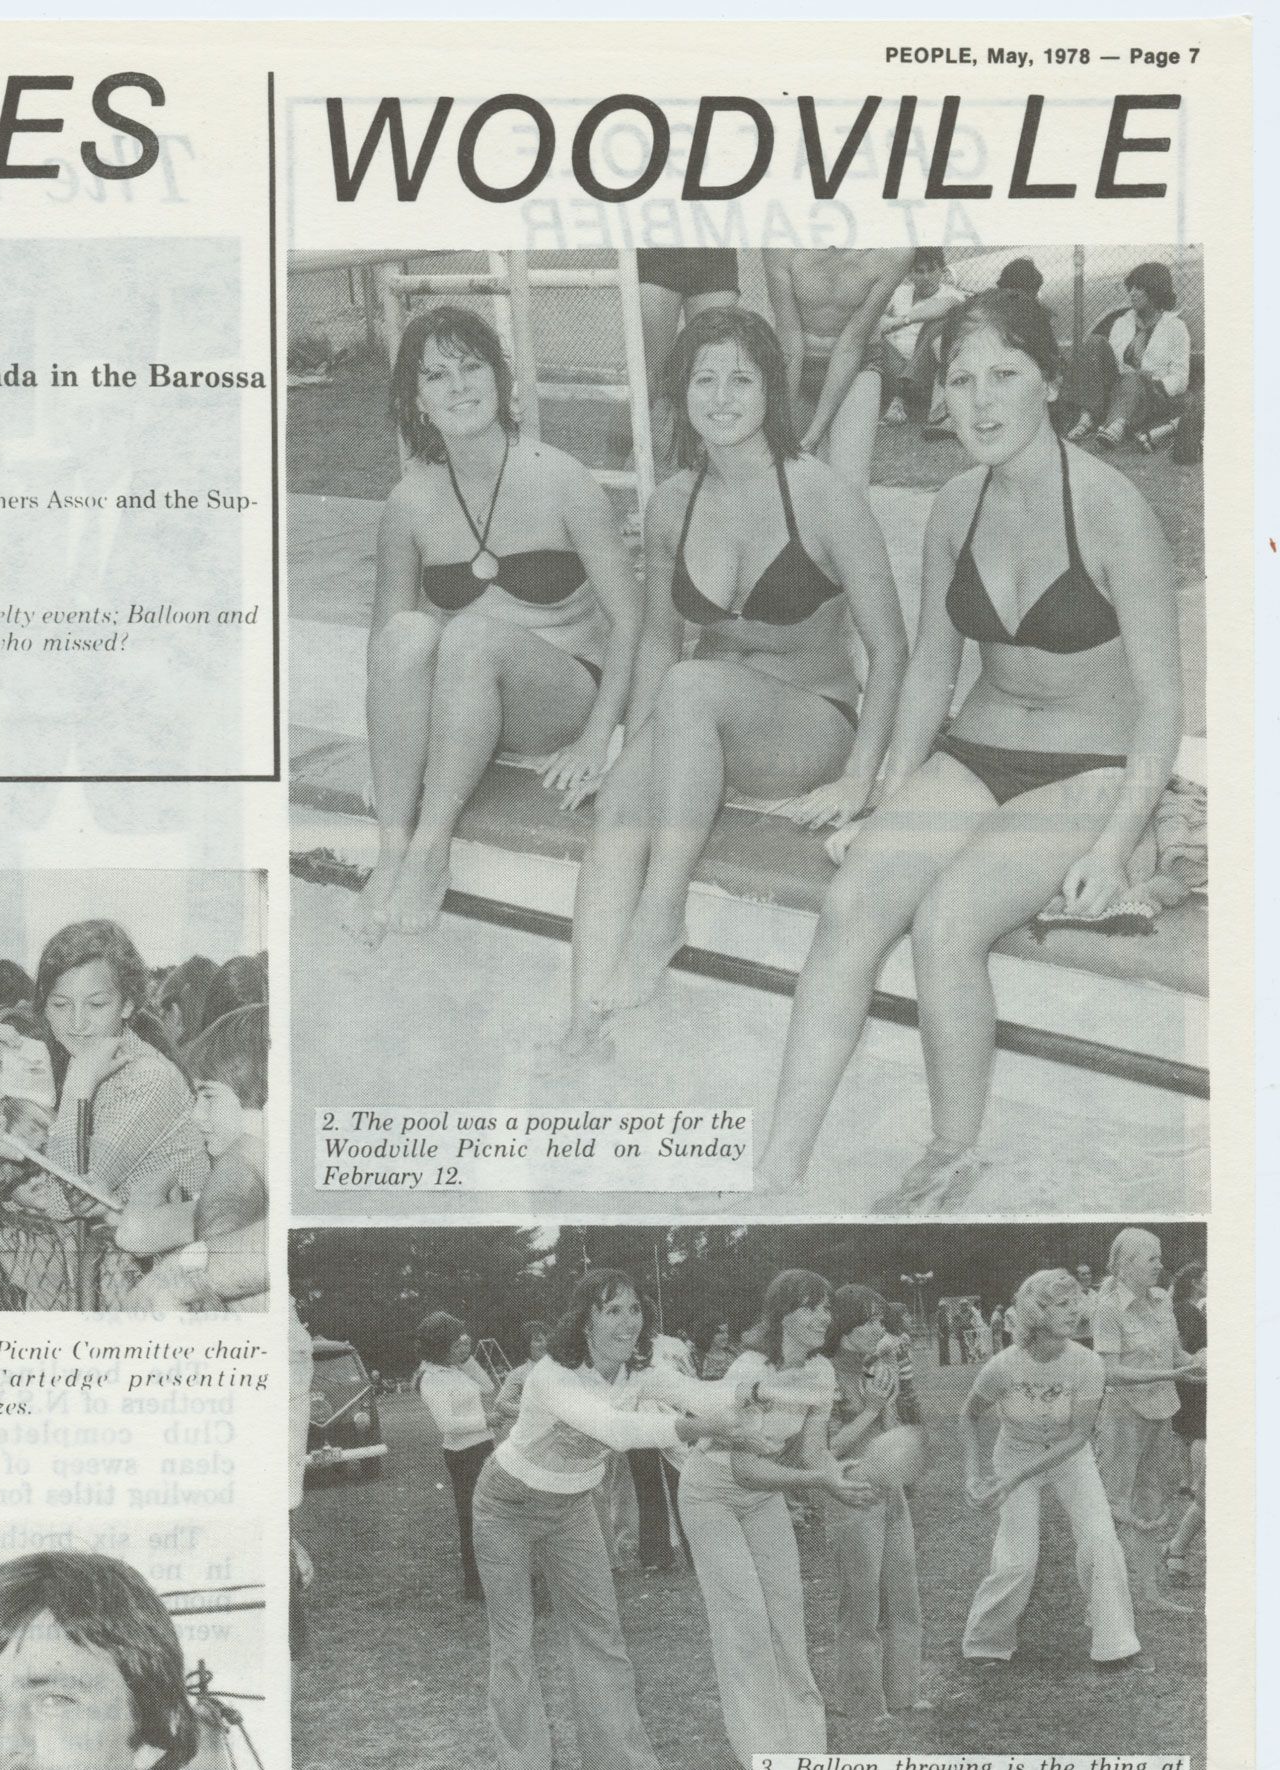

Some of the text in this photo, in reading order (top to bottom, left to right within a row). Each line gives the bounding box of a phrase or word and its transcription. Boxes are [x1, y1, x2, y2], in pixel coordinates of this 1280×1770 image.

[885, 46, 978, 67] PEOPLE,
[987, 47, 1034, 69] May,
[1043, 47, 1091, 65] 1978
[1130, 47, 1181, 69] Page
[1188, 47, 1201, 64] 7
[326, 92, 1181, 203] WOODVILLE
[50, 363, 79, 387] in
[91, 363, 137, 388] the
[148, 363, 267, 389] Barossa
[127, 604, 210, 624] Balloon
[217, 605, 259, 625] and
[43, 631, 129, 652] missed?
[321, 1110, 746, 1136] 2. The pool was a popular spot for the
[325, 1137, 746, 1162] Woodville Picnic held on Sunday
[322, 1165, 463, 1190] February 12.
[72, 1340, 195, 1360] Committee
[204, 1340, 267, 1360] chair-
